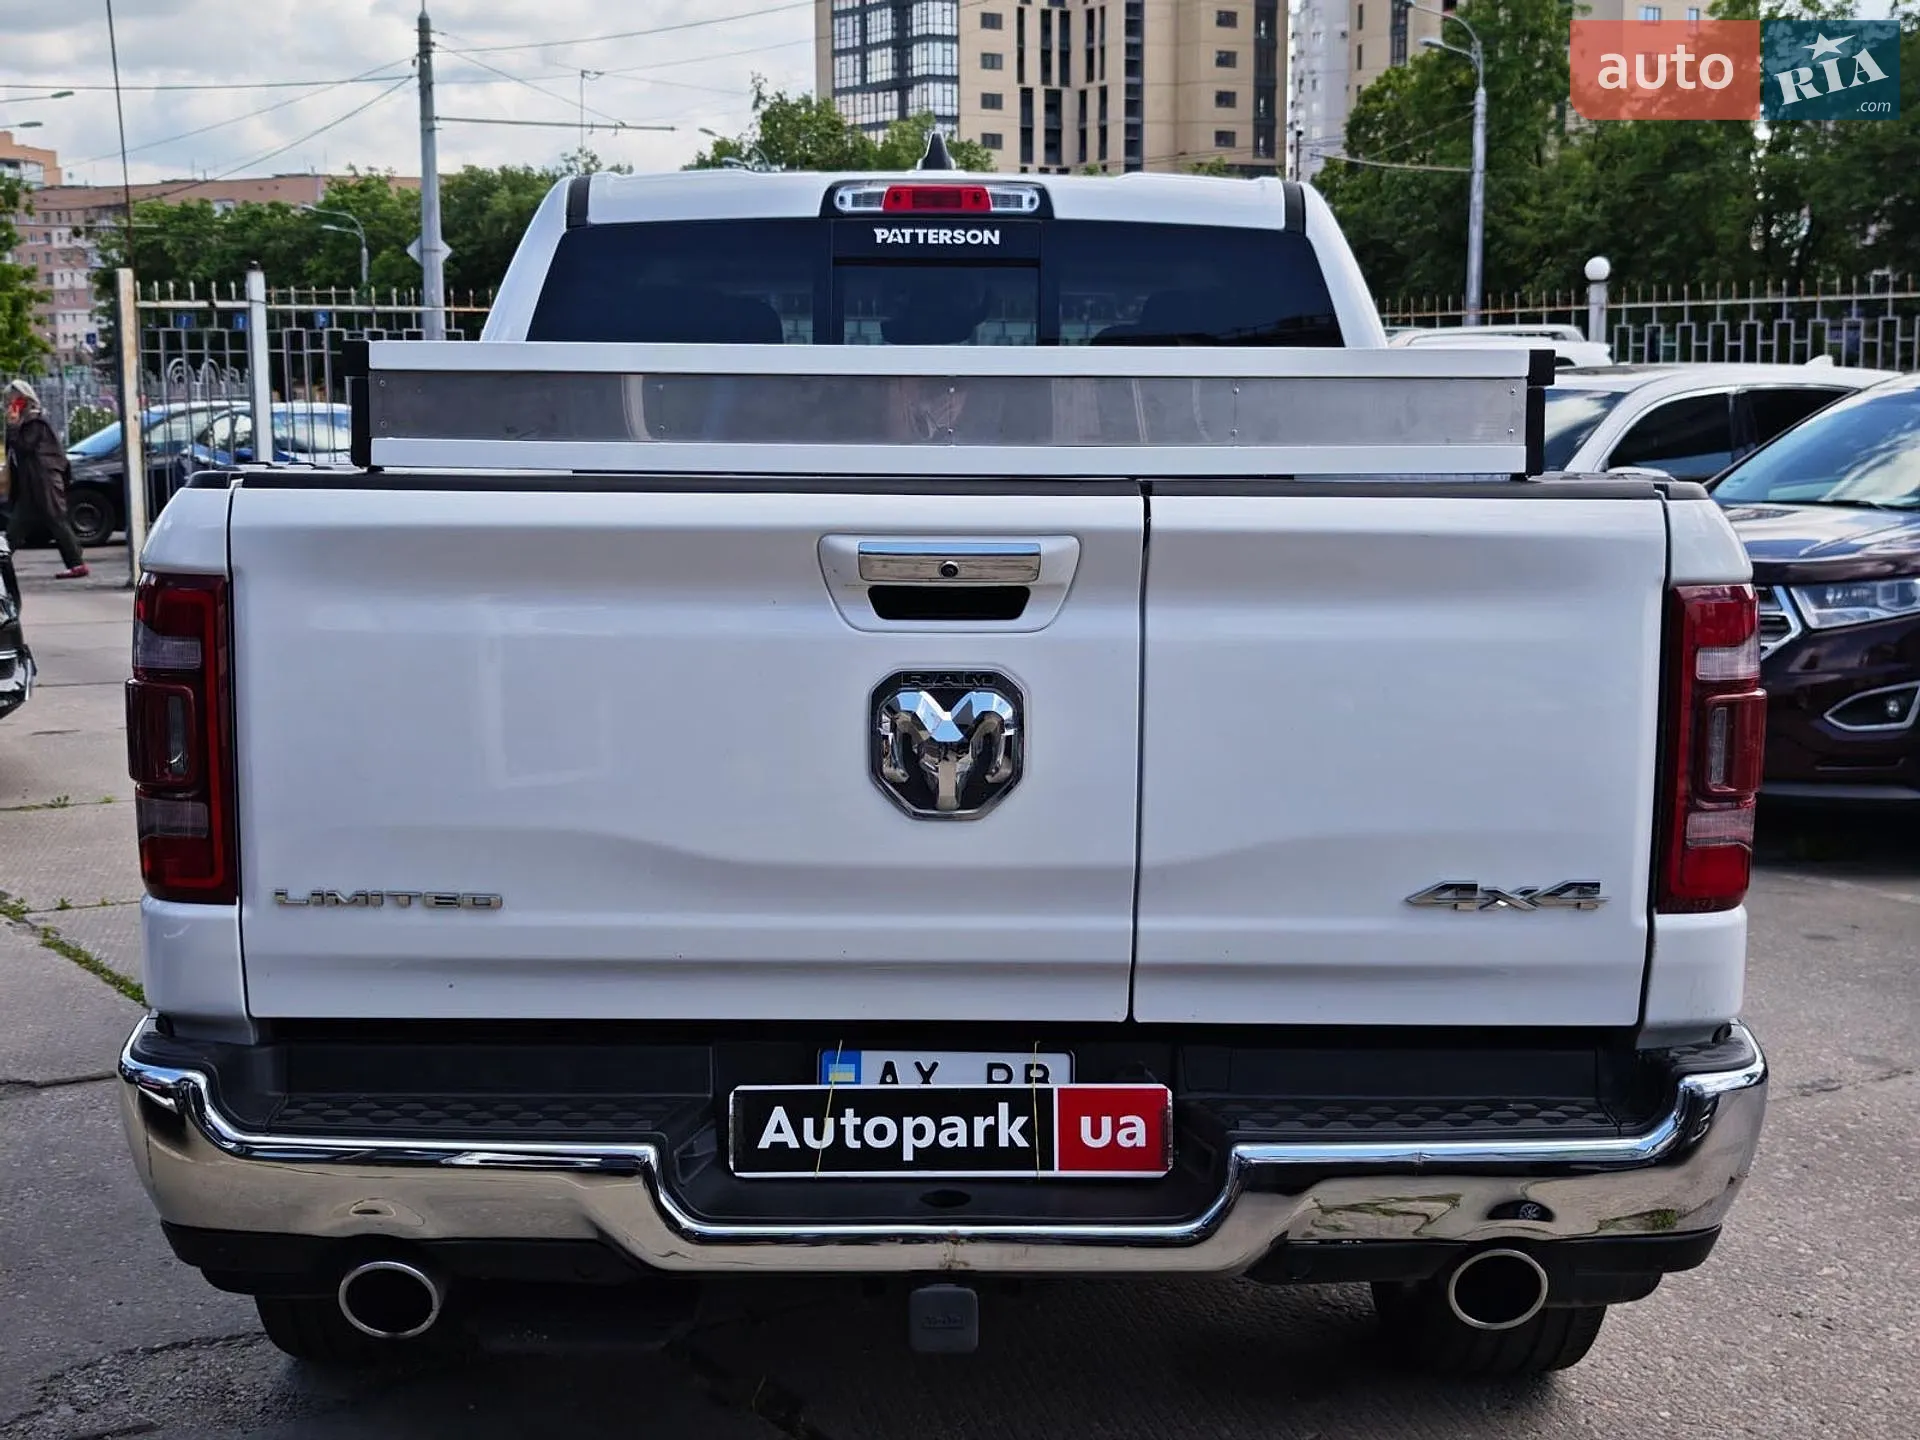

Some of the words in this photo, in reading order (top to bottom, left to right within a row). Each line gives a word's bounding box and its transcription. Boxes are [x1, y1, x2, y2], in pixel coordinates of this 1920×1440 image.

[874, 228, 1000, 245] PATTERSON
[901, 672, 995, 687] RAM
[274, 889, 504, 908] LIMITED
[757, 1102, 1029, 1162] Autopark
[1080, 1114, 1147, 1149] ua
